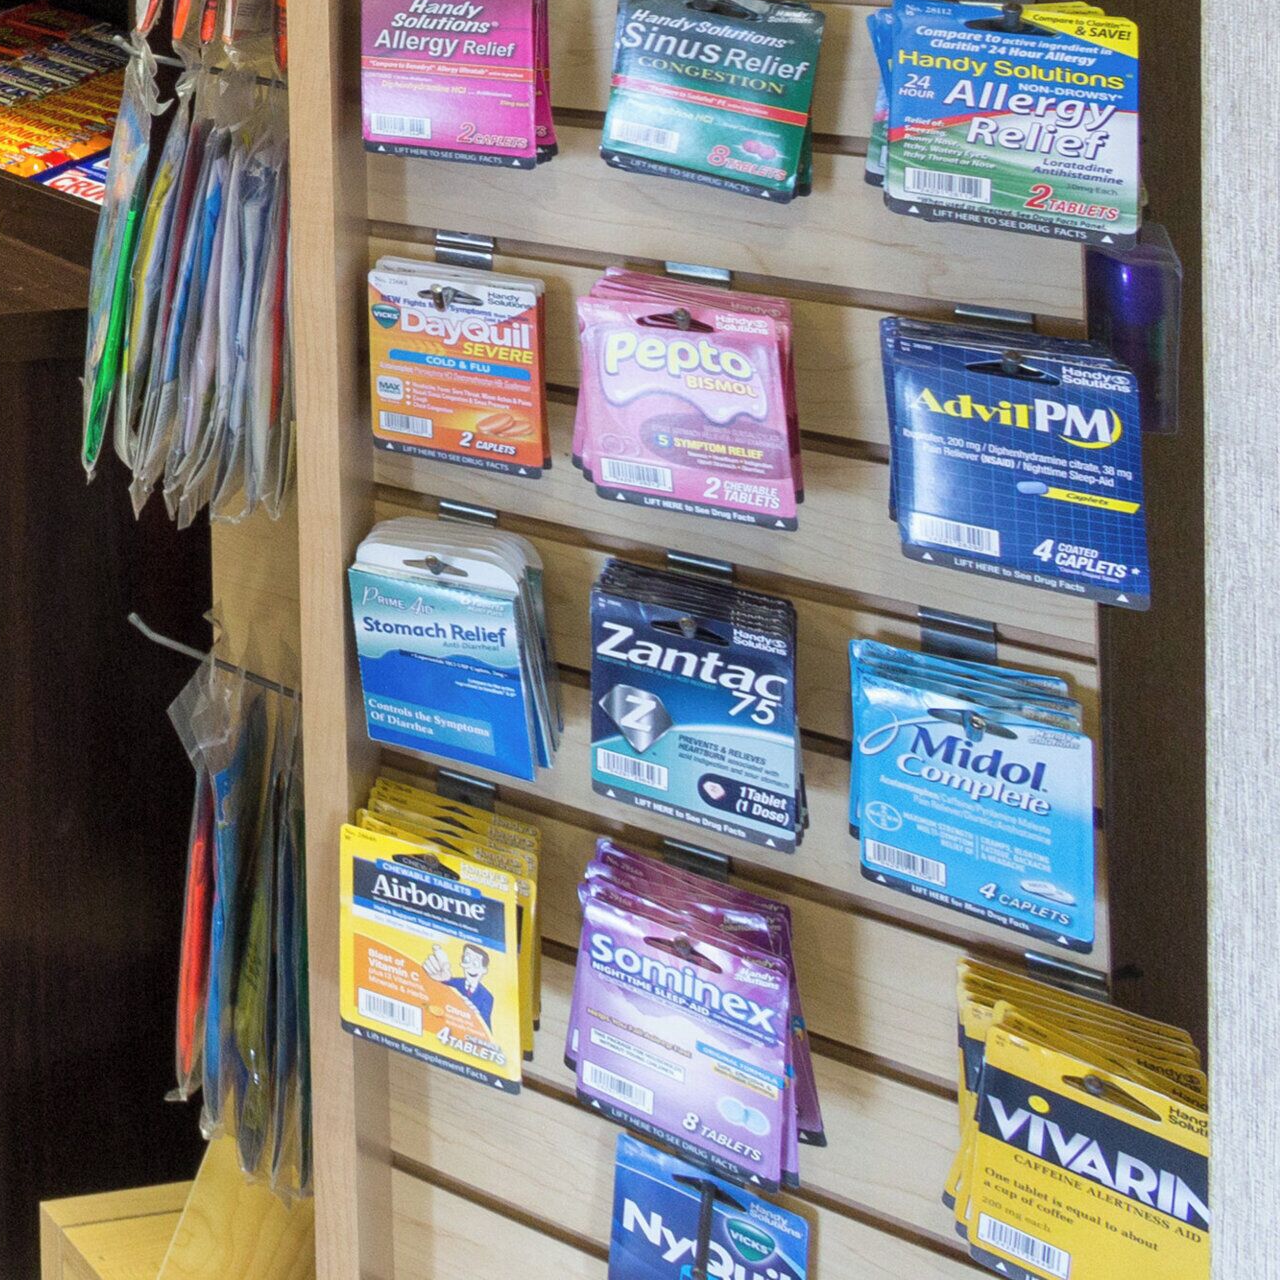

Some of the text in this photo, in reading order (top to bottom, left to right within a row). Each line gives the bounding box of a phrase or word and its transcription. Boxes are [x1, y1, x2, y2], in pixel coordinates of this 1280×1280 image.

[391, 13, 491, 34] Solutions
[1075, 26, 1132, 41] & SAVE!
[374, 29, 515, 57] Allergy Relief
[620, 22, 811, 81] Sinus Relief
[930, 38, 1097, 67] Claritin 24 Hour Allergy
[637, 56, 786, 95] CONGESTION
[897, 49, 1125, 90] Handy Solutions
[903, 73, 931, 88] 24
[898, 87, 935, 99] HOUR
[943, 79, 1116, 131] Allergy
[966, 117, 1109, 160] Relief
[1032, 166, 1124, 185] Antihistamine
[1042, 158, 1114, 175] Loratadine
[1024, 184, 1119, 220] 2 TABLETS
[400, 307, 530, 349] DayQuil
[715, 321, 769, 335] Solutions
[425, 355, 491, 373] COLD & FLU
[462, 342, 534, 364] SEVERE
[605, 332, 754, 382] Pepto
[686, 375, 758, 397] BISMOL
[1061, 366, 1112, 382] Handy
[1062, 376, 1131, 393] Solutions
[911, 387, 1112, 444] Advil PM
[459, 431, 516, 455] 2 CAPLETS
[703, 477, 722, 499] 2
[723, 480, 778, 496] CHEWABLE
[723, 486, 780, 509] TABLETS
[1066, 492, 1110, 506] Caplets
[1032, 538, 1055, 562] 4
[1057, 542, 1098, 558] COATED
[1054, 552, 1127, 578] CAPLETS
[362, 616, 507, 648] Stomach Relief
[733, 635, 788, 656] Solutions
[596, 621, 788, 701] Zantac
[368, 698, 490, 737] Controls the Symptoms
[620, 694, 657, 732] Z
[728, 690, 776, 725] 75
[909, 725, 1047, 791] Midol
[896, 753, 1052, 817] Complete
[735, 799, 790, 826] (1 Dose)
[382, 862, 472, 896] CHEWABLE TABLETS
[371, 873, 486, 921] Airborne
[978, 882, 1072, 926] 4 CAPLETS
[589, 932, 776, 1035] Sominex
[445, 1004, 471, 1017] Citrus
[435, 1027, 506, 1066] 4 TABLETS
[681, 1111, 763, 1162] 8 TABLETS
[986, 1094, 1210, 1225] VIVARIN
[984, 1167, 1159, 1252] One tablet is equal to about
[1013, 1153, 1202, 1244] CAFFEINE ALERTNESS AID
[749, 1209, 802, 1239] Solutions
[730, 1230, 769, 1254] VICKS
